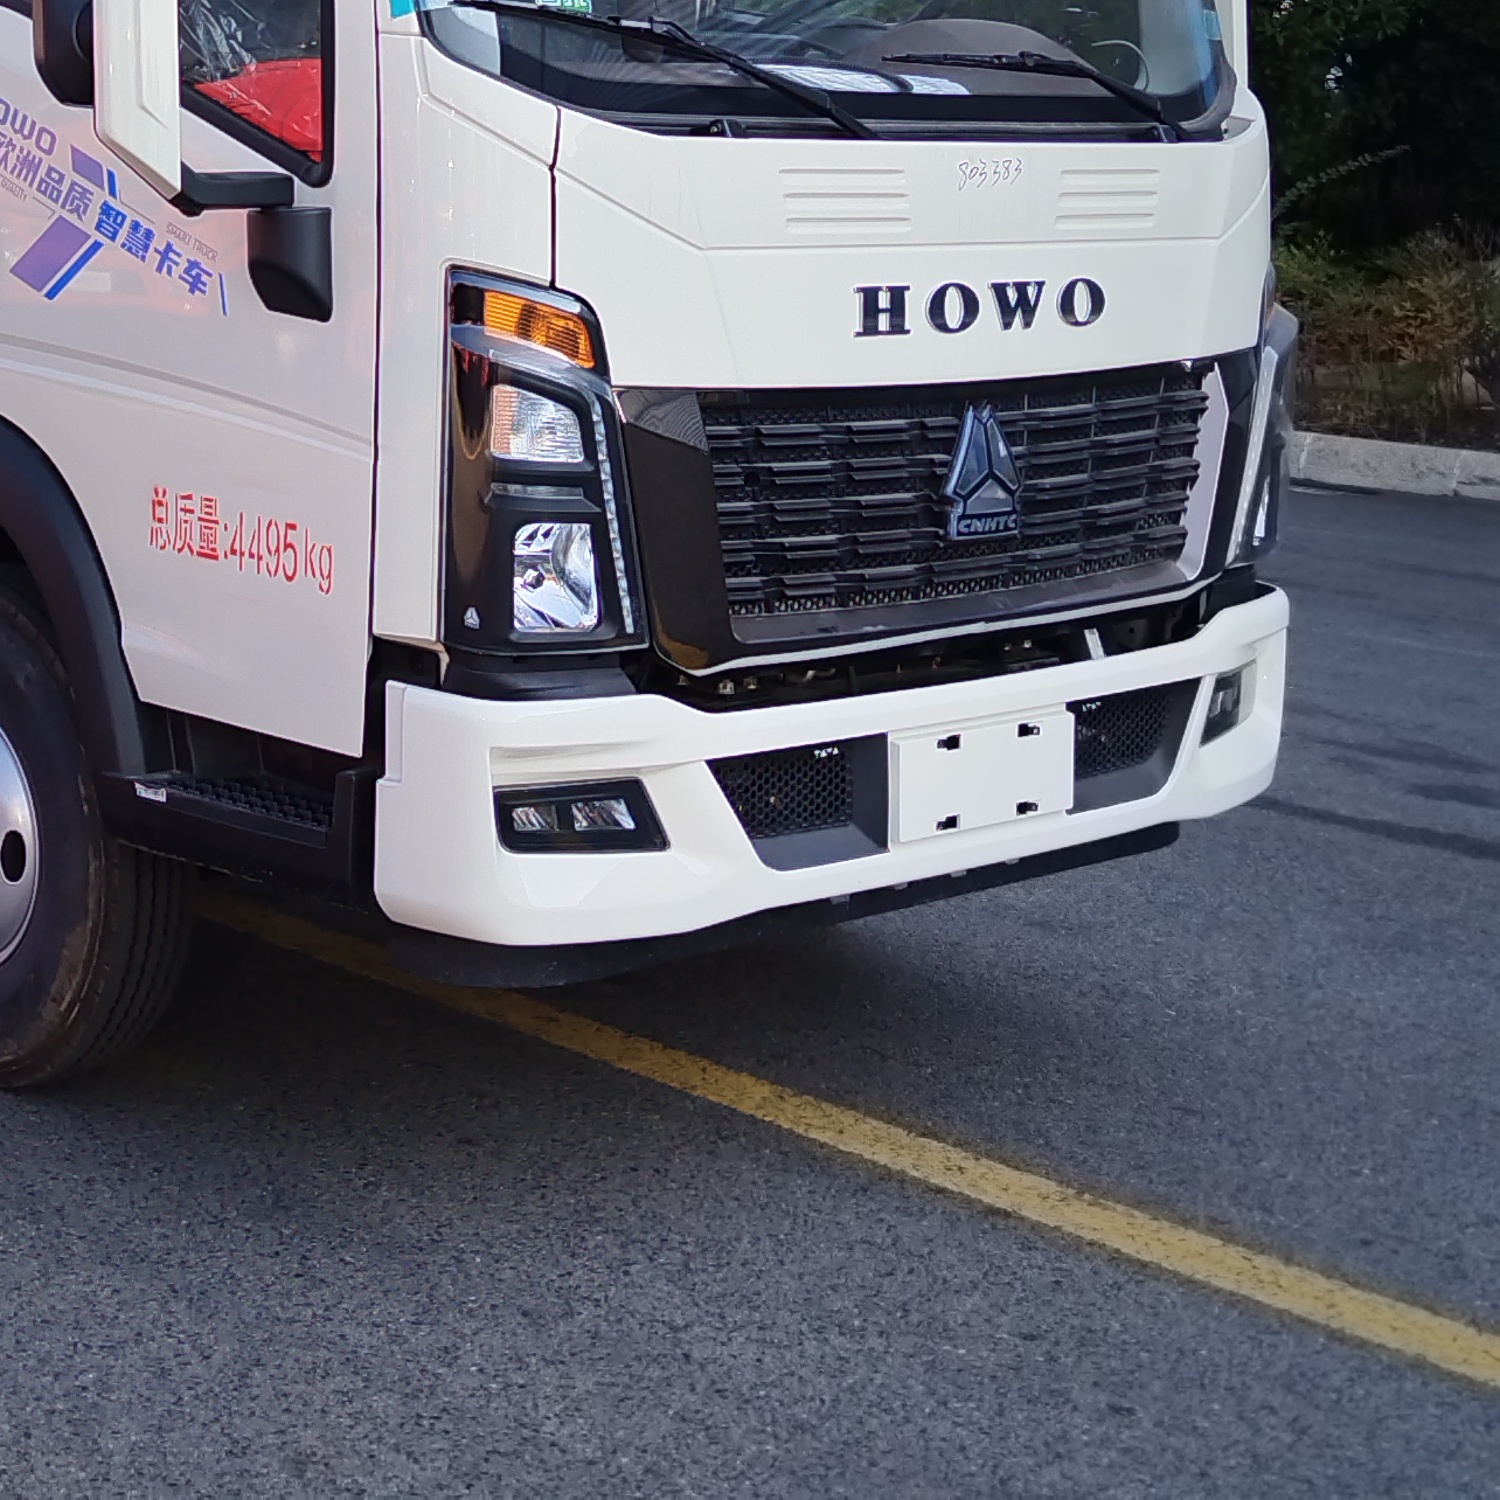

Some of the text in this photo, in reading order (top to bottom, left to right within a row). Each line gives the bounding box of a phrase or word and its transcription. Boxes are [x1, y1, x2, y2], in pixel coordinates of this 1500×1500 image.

[94, 199, 213, 296] 智慧卡车
[852, 276, 1107, 338] HOWO
[957, 514, 1018, 533] CNHTC
